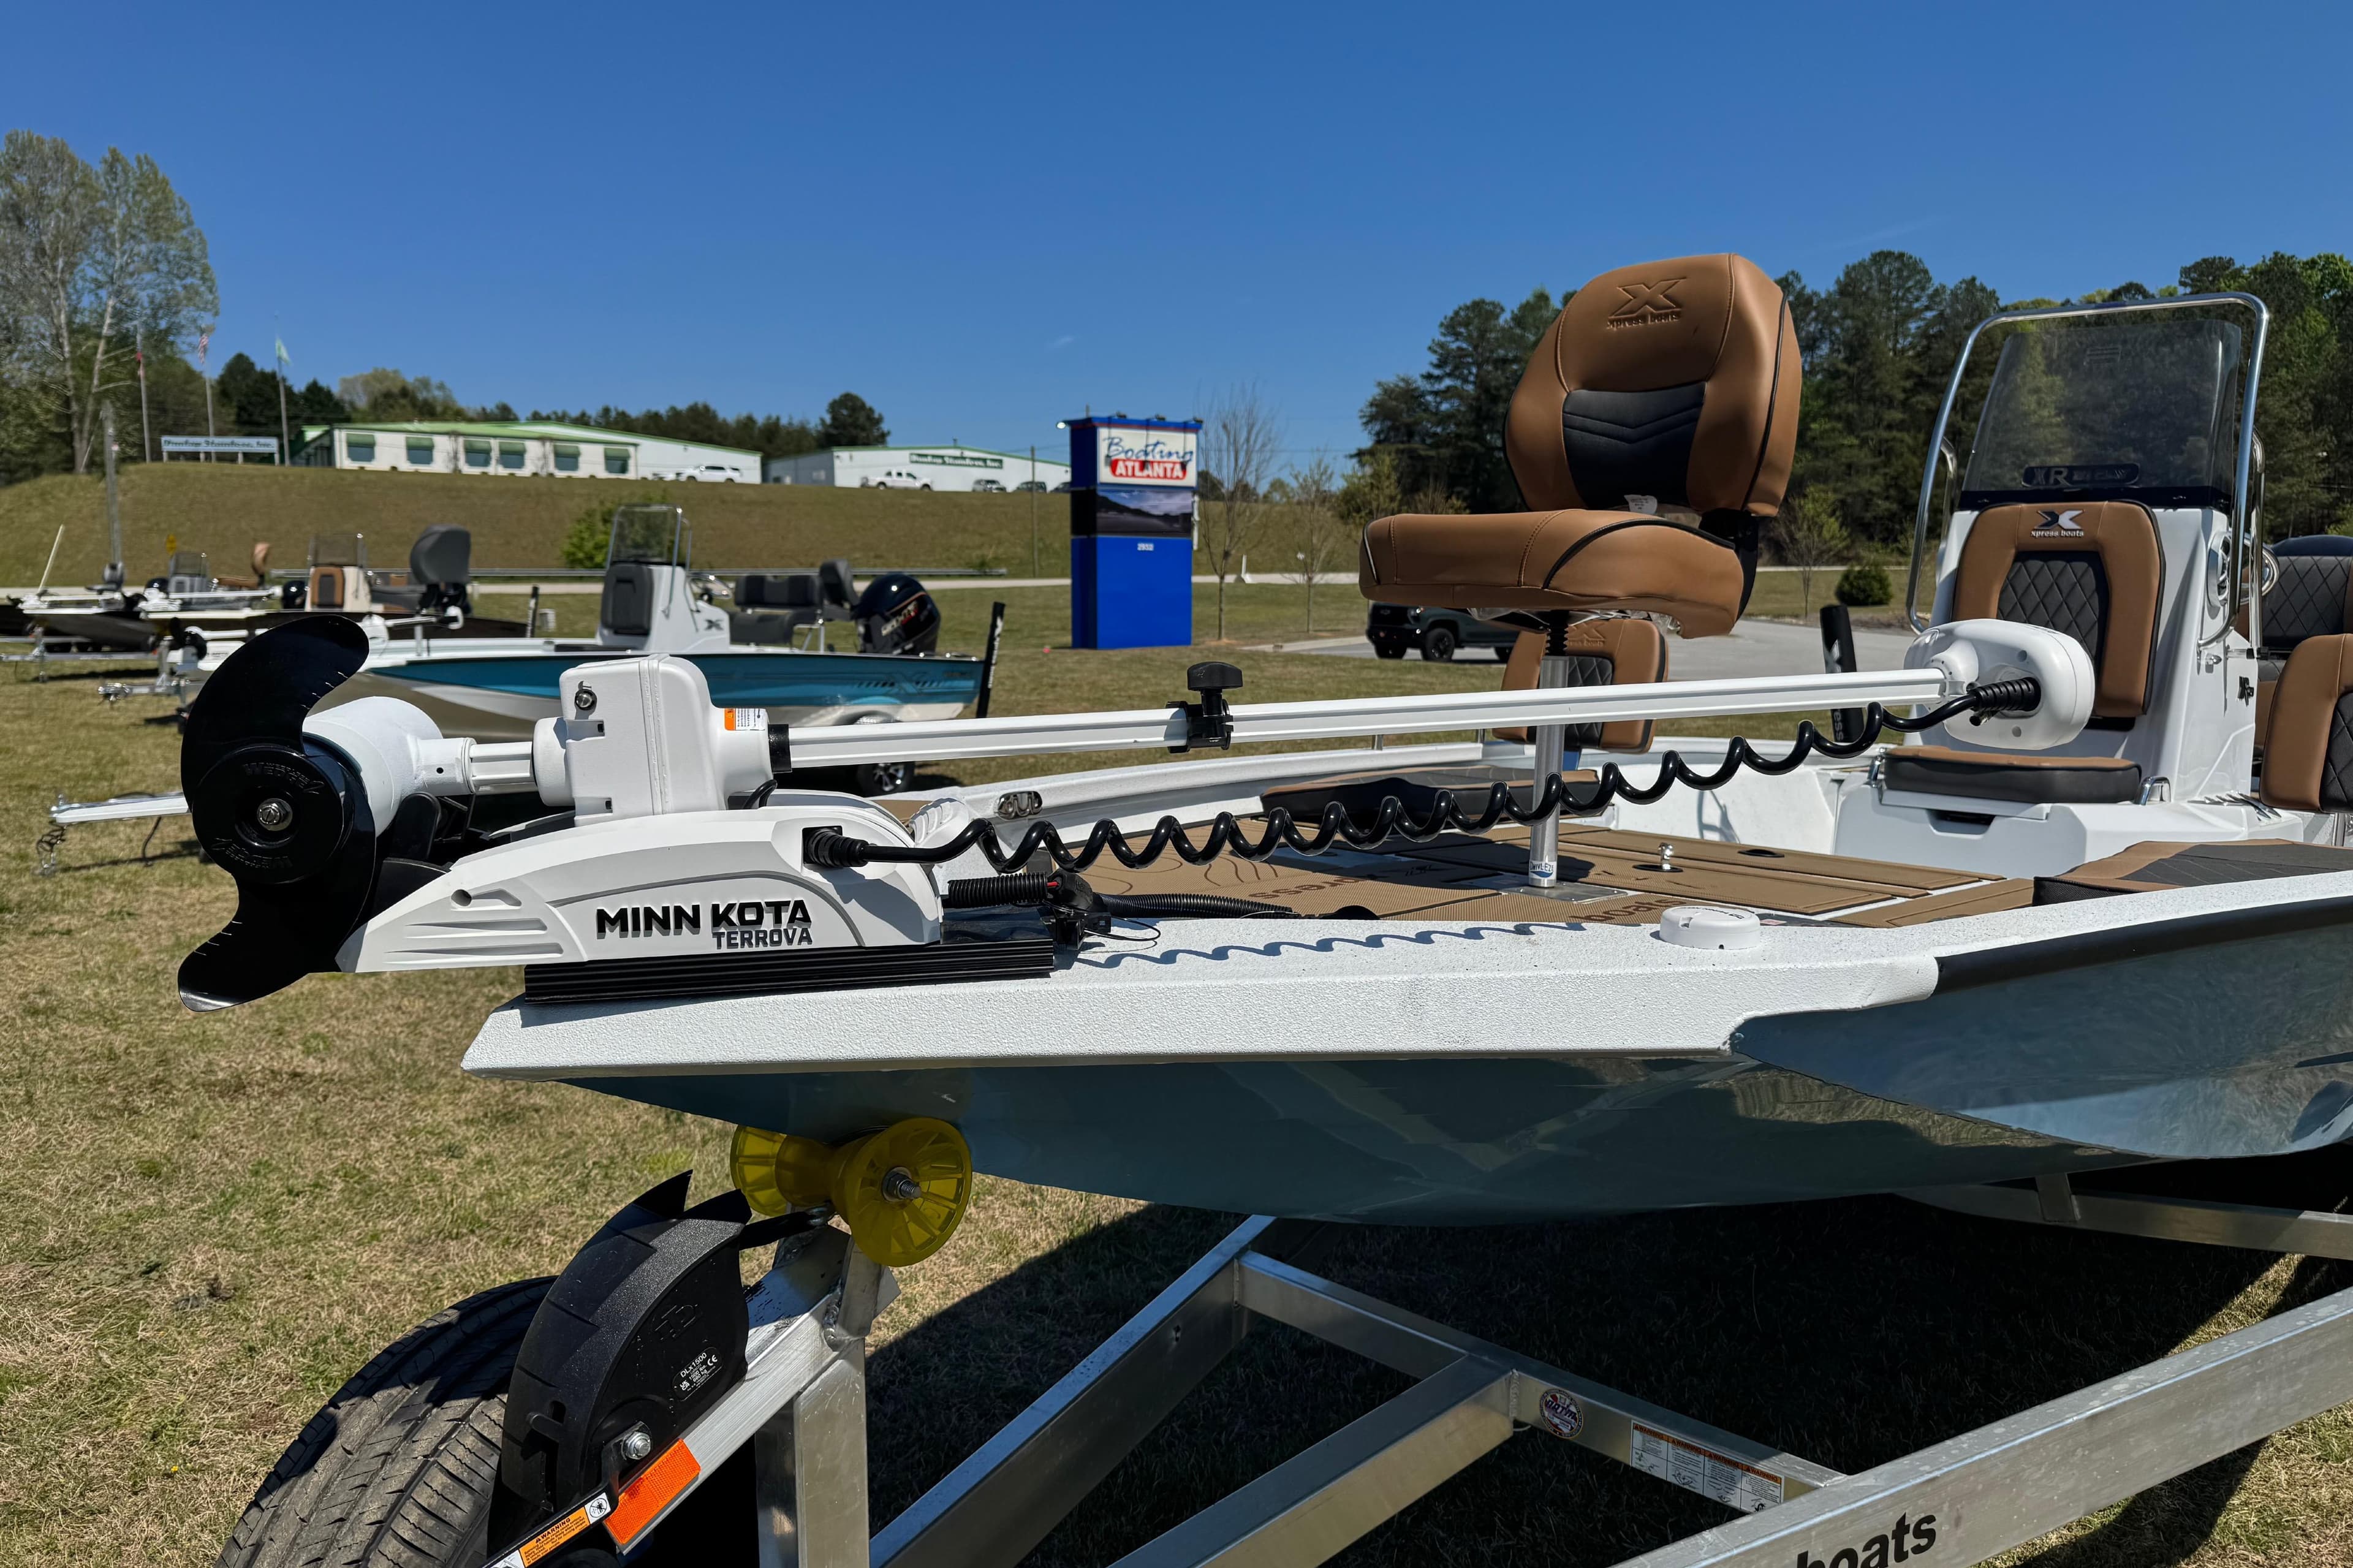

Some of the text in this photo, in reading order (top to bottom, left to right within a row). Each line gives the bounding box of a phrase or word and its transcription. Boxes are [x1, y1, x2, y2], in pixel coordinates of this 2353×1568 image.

[1103, 436, 1194, 466] Boating
[1115, 461, 1183, 478] ATLANTA
[597, 900, 813, 937] MINN KOTA
[1569, 899, 1686, 922] boats
[712, 928, 813, 950] TERROVA
[1751, 1468, 1778, 1482] WARNING
[541, 1517, 570, 1539] WARNING
